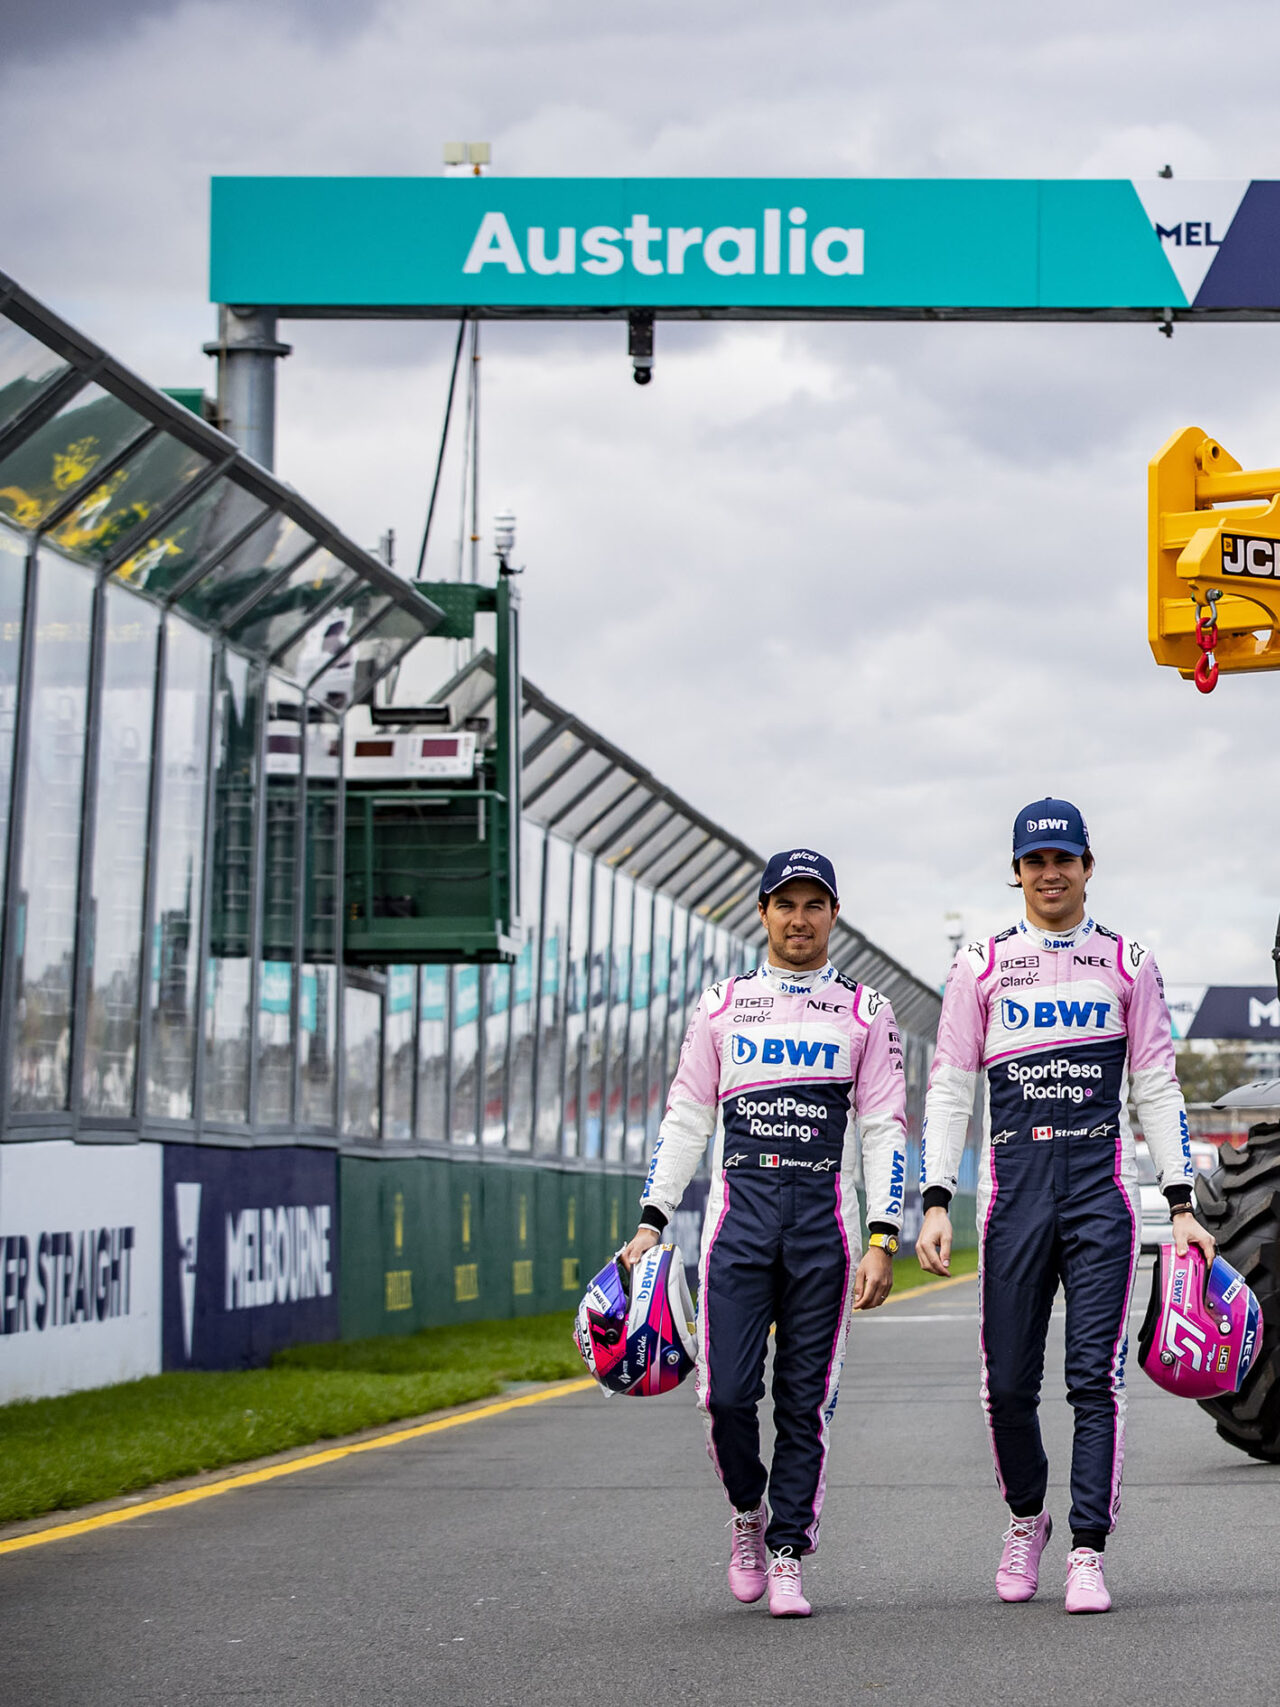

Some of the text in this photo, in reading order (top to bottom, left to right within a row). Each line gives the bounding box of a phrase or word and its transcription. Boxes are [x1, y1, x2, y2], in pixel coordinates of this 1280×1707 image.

[462, 207, 866, 278] Australia
[1155, 222, 1224, 247] MEL
[1038, 818, 1069, 831] BWT
[1001, 956, 1039, 971] JCB
[1073, 956, 1113, 969] NEC
[1000, 972, 1036, 987] Claro
[736, 997, 774, 1008] JCB
[807, 1000, 847, 1014] NEC
[733, 1012, 768, 1023] Claro
[1034, 1001, 1111, 1028] BWT
[761, 1038, 840, 1069] BWT
[1007, 1059, 1102, 1084] SportPesa
[1023, 1083, 1086, 1103] Racing
[736, 1097, 828, 1120] SportPesa
[750, 1120, 813, 1143] Racing
[1054, 1127, 1088, 1138] Stroll
[889, 1150, 906, 1199] BWT
[225, 1205, 332, 1311] MELBOURNE
[0, 1226, 136, 1335] ER STRAIGHT
[641, 1260, 657, 1289] BWT
[1172, 1278, 1184, 1304] BWT
[1218, 1348, 1229, 1371] JCB
[1241, 1330, 1255, 1368] NEC
